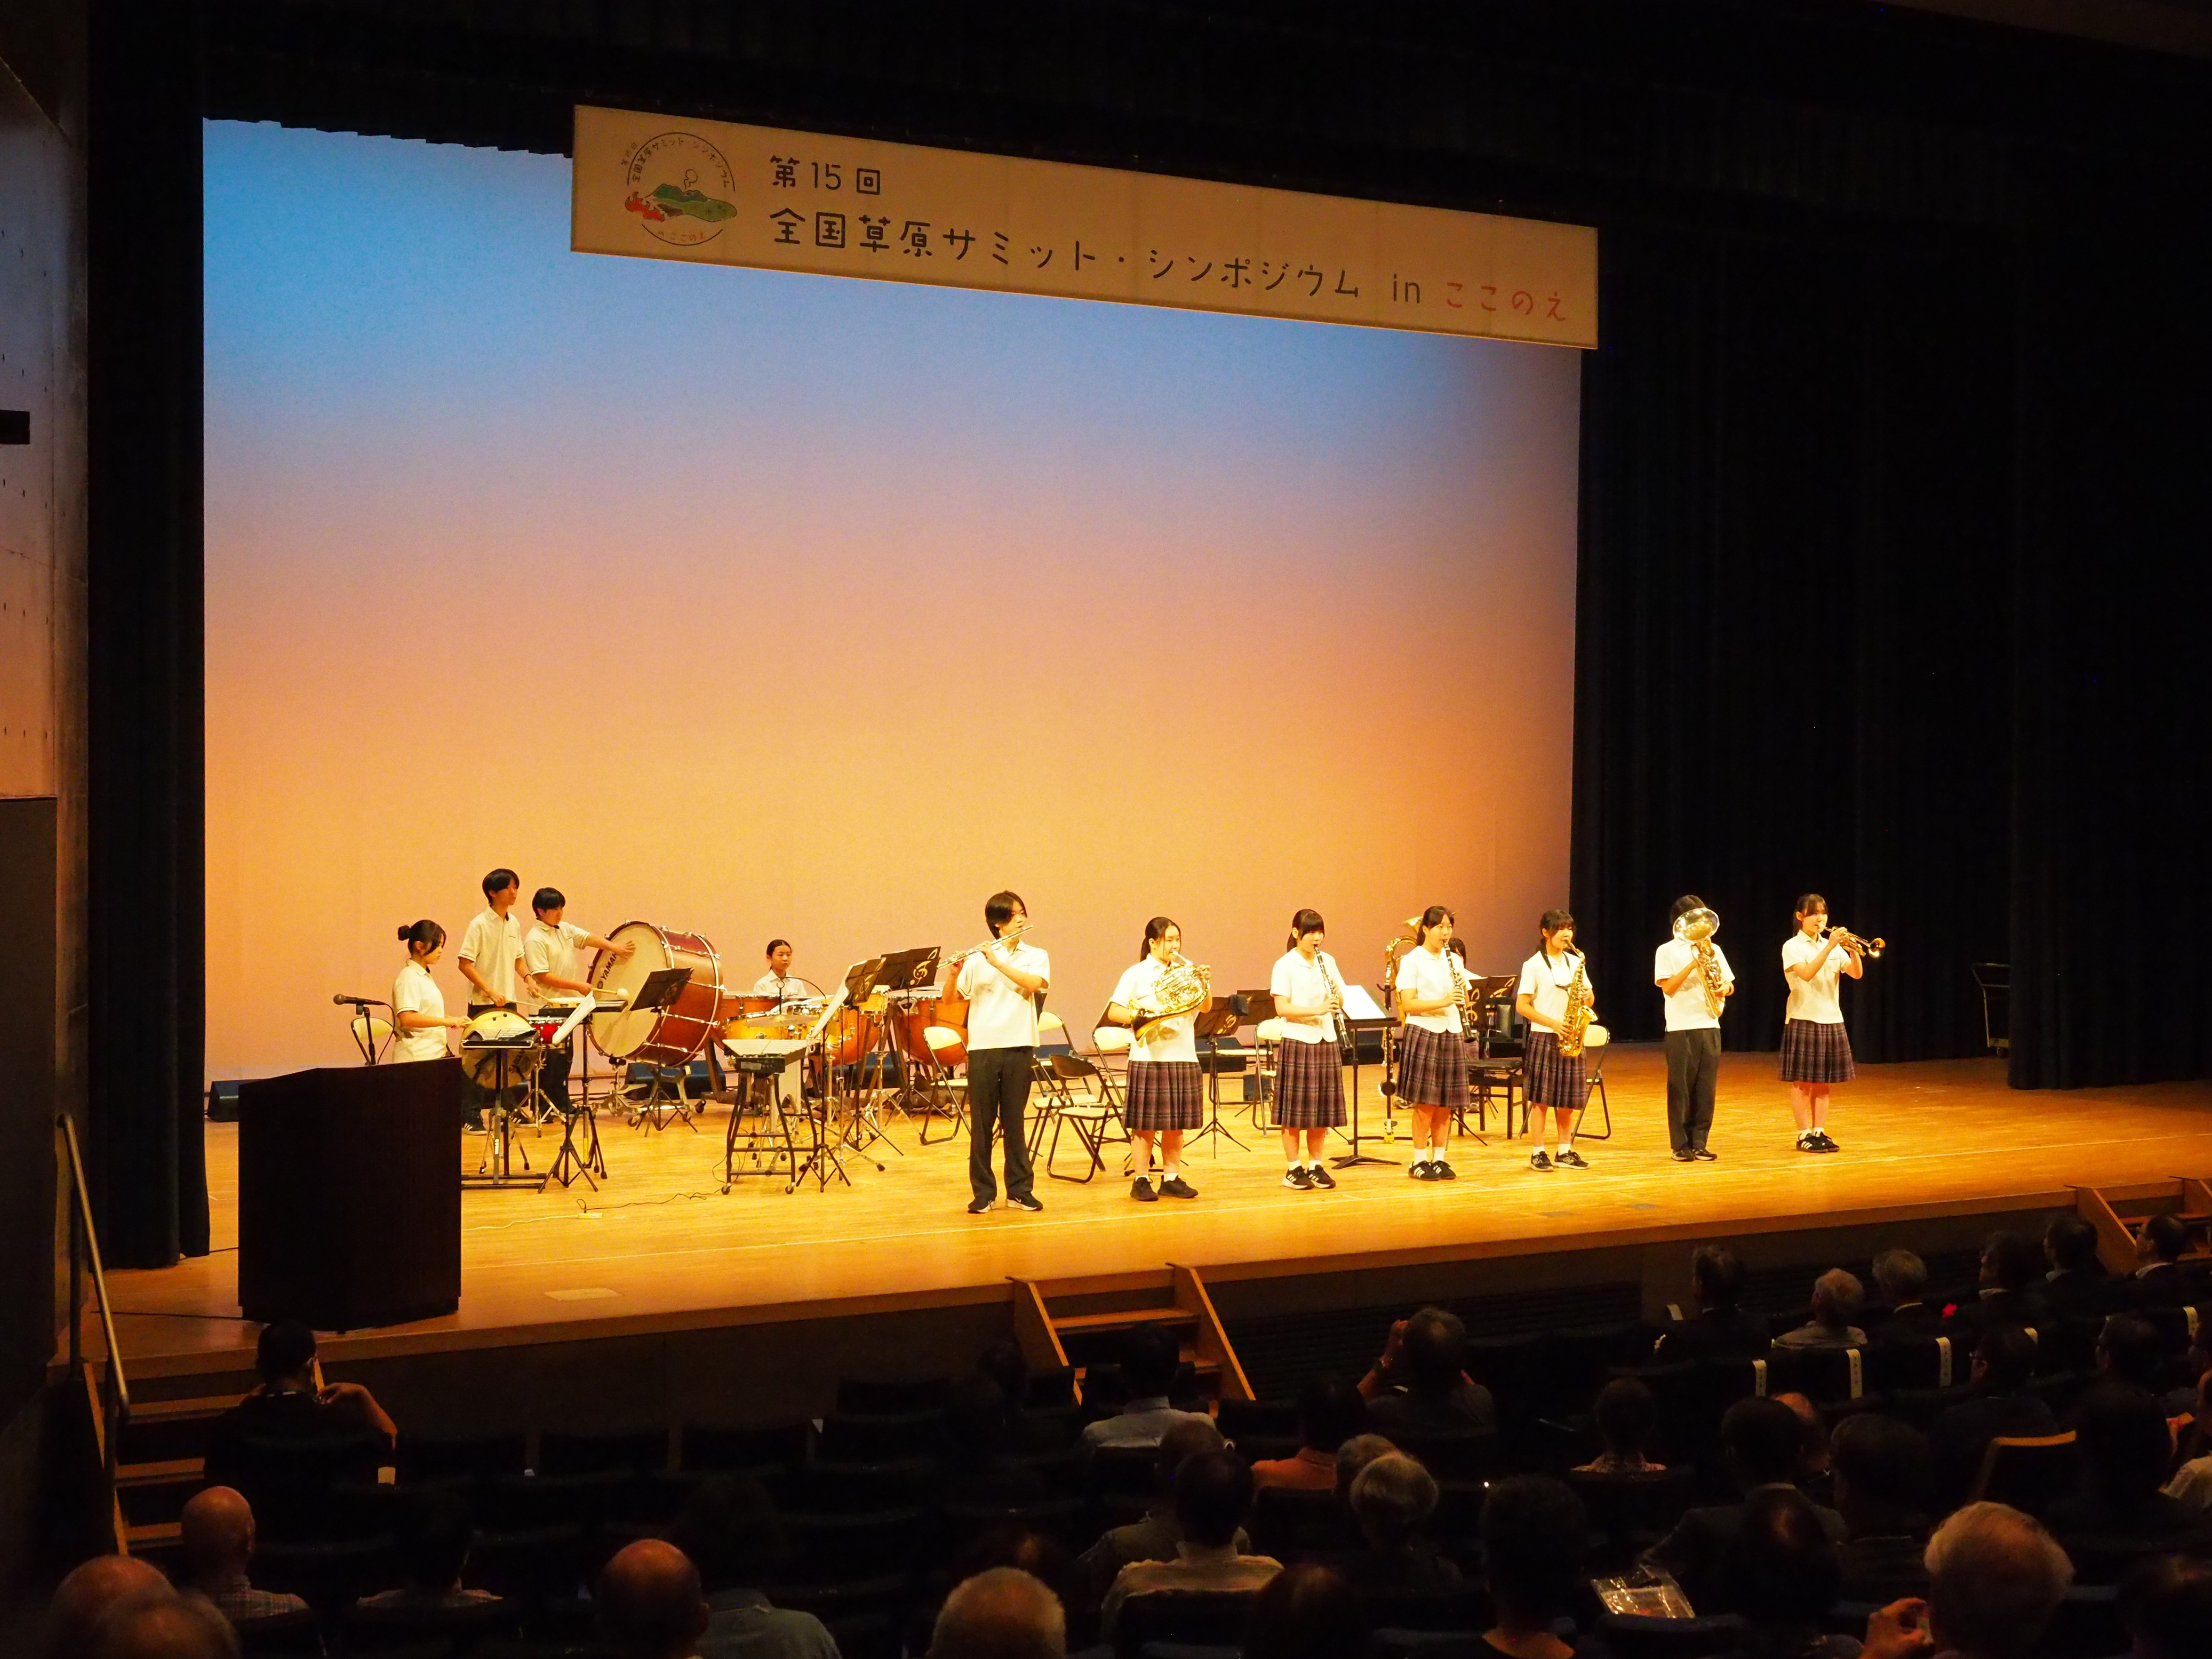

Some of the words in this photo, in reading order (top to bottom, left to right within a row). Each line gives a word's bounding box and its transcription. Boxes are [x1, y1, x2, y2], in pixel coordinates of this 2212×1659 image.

[770, 155, 881, 196] 第15回
[769, 208, 1359, 298] 全国草原サミット・シンポジウム
[1393, 273, 1420, 304] in
[1446, 282, 1566, 322] ここのえ
[601, 953, 618, 980] YAMAH
